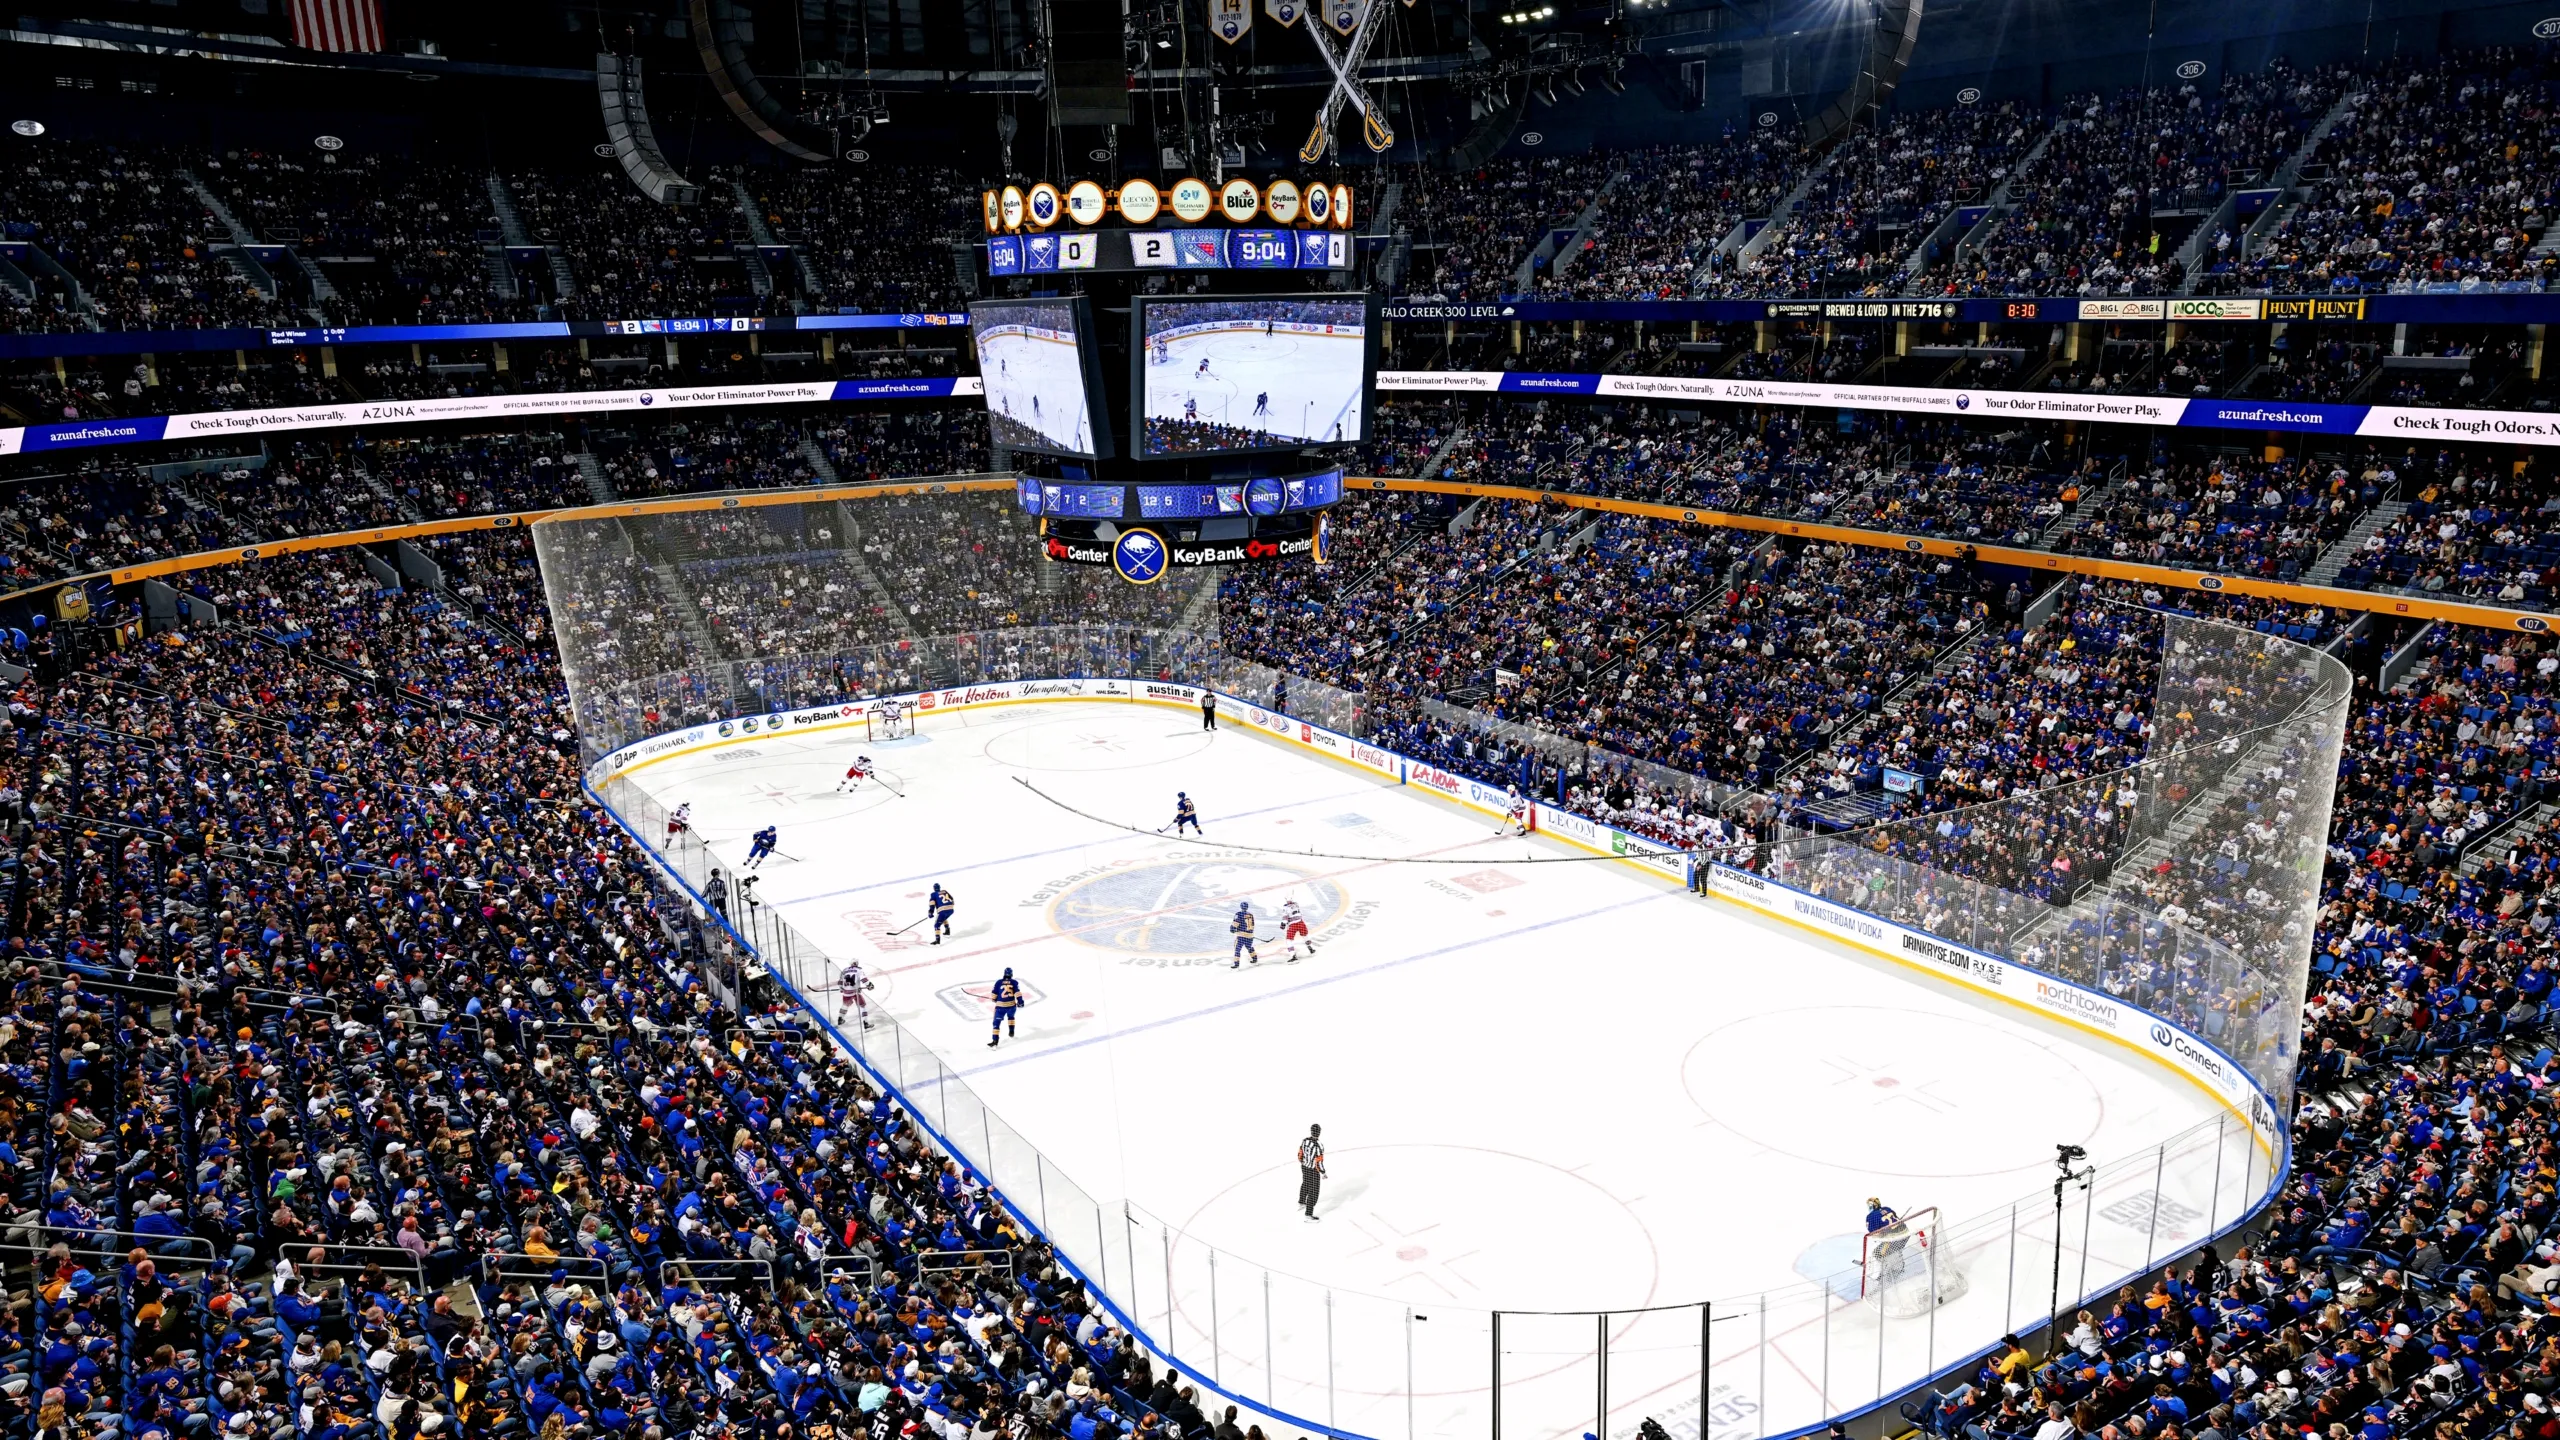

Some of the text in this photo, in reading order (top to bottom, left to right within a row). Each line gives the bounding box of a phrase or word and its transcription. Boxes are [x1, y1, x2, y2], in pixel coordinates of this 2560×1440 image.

[2543, 23, 2560, 34] 307
[2184, 64, 2199, 75] 306
[1962, 90, 1974, 100] 305
[852, 152, 863, 160] 300
[1003, 200, 1021, 209] KeyBank
[1227, 196, 1255, 208] Blue
[1272, 194, 1298, 203] KeyBank
[1069, 242, 1081, 260] 0
[1147, 240, 1160, 258] 2
[1242, 242, 1286, 261] 9:04
[1334, 241, 1340, 259] 0
[994, 248, 1015, 266] 9:04
[1410, 307, 1443, 318] CREEK
[1445, 307, 1466, 317] 300
[1470, 306, 1499, 317] LEVEL
[1826, 304, 1942, 317] BREWED & LOVED IN THE 716
[2008, 304, 2035, 317] 8:30
[2100, 304, 2119, 312] BIG L
[2140, 304, 2160, 312] BIG L
[2174, 302, 2218, 315] NOCO
[2270, 302, 2305, 314] HUNT
[2317, 302, 2353, 314] HUNT
[674, 321, 700, 331] 9:04
[737, 320, 744, 329] 0
[924, 314, 948, 326] 50/50
[628, 323, 636, 332] 2
[1381, 376, 1488, 386] Odor Eliminator Power Play.
[1520, 379, 1579, 388] azunafresh.com
[858, 384, 930, 393] azunafresh.com
[1614, 381, 1715, 395] Check Tough Odors. Naturally.
[1726, 386, 1764, 398] AZUNA
[668, 388, 818, 402] Your Odor Eliminator Power Play.
[1928, 396, 1951, 405] SABRES
[531, 400, 560, 408] PARTNER
[1985, 398, 2161, 418] Your Odor Eliminator Power Play.
[362, 406, 415, 419] AZUNA
[2218, 409, 2323, 424] azunafresh.com
[190, 411, 347, 430] Check Tough Odors. Naturally.
[2393, 416, 2440, 429] Check
[2442, 418, 2491, 434] Tough
[2494, 420, 2546, 435] Odors.
[50, 426, 137, 442] azunafresh.com
[1309, 484, 1324, 494] 7 2
[1026, 492, 1039, 502] SHOTS
[1065, 494, 1118, 506] 7 2 9
[1144, 496, 1157, 506] 12
[1201, 495, 1214, 505] 17
[1252, 493, 1280, 503] SHOTS
[1279, 538, 1314, 554] Center
[1068, 545, 1109, 563] Center
[1174, 546, 1246, 565] KeyBank
[2204, 579, 2216, 588] 106
[2524, 619, 2539, 629] 107
[1019, 683, 1068, 697] Yuengling
[1147, 685, 1180, 697] austin
[1182, 688, 1195, 699] air
[942, 688, 1011, 706] Tim Hortons
[794, 709, 839, 725] KeyBank
[641, 737, 687, 755] HIGHMARK
[1312, 732, 1337, 748] TOYOTA
[1357, 745, 1384, 768] Coca-Cola
[1412, 763, 1431, 780] LA
[1431, 767, 1460, 794] NOVA
[1548, 811, 1596, 838] LECOM
[1165, 851, 1267, 860] Center
[1615, 838, 1680, 868] enterprise
[1018, 864, 1113, 908] KeyBank
[1723, 869, 1765, 891] SCHOLARS
[1424, 879, 1475, 902] TOYOTA
[1742, 888, 1772, 906] UNIVERSITY
[1794, 899, 1883, 940] NEW AMSTERDAM VODKA
[1903, 934, 1970, 970] DRINKRYSE.COM
[1973, 959, 2002, 975] RYSE
[1000, 985, 1014, 998] 25
[2037, 982, 2117, 1021] northtown
[2036, 995, 2116, 1029] automotive companies
[2175, 1038, 2238, 1091] ConnectLife
